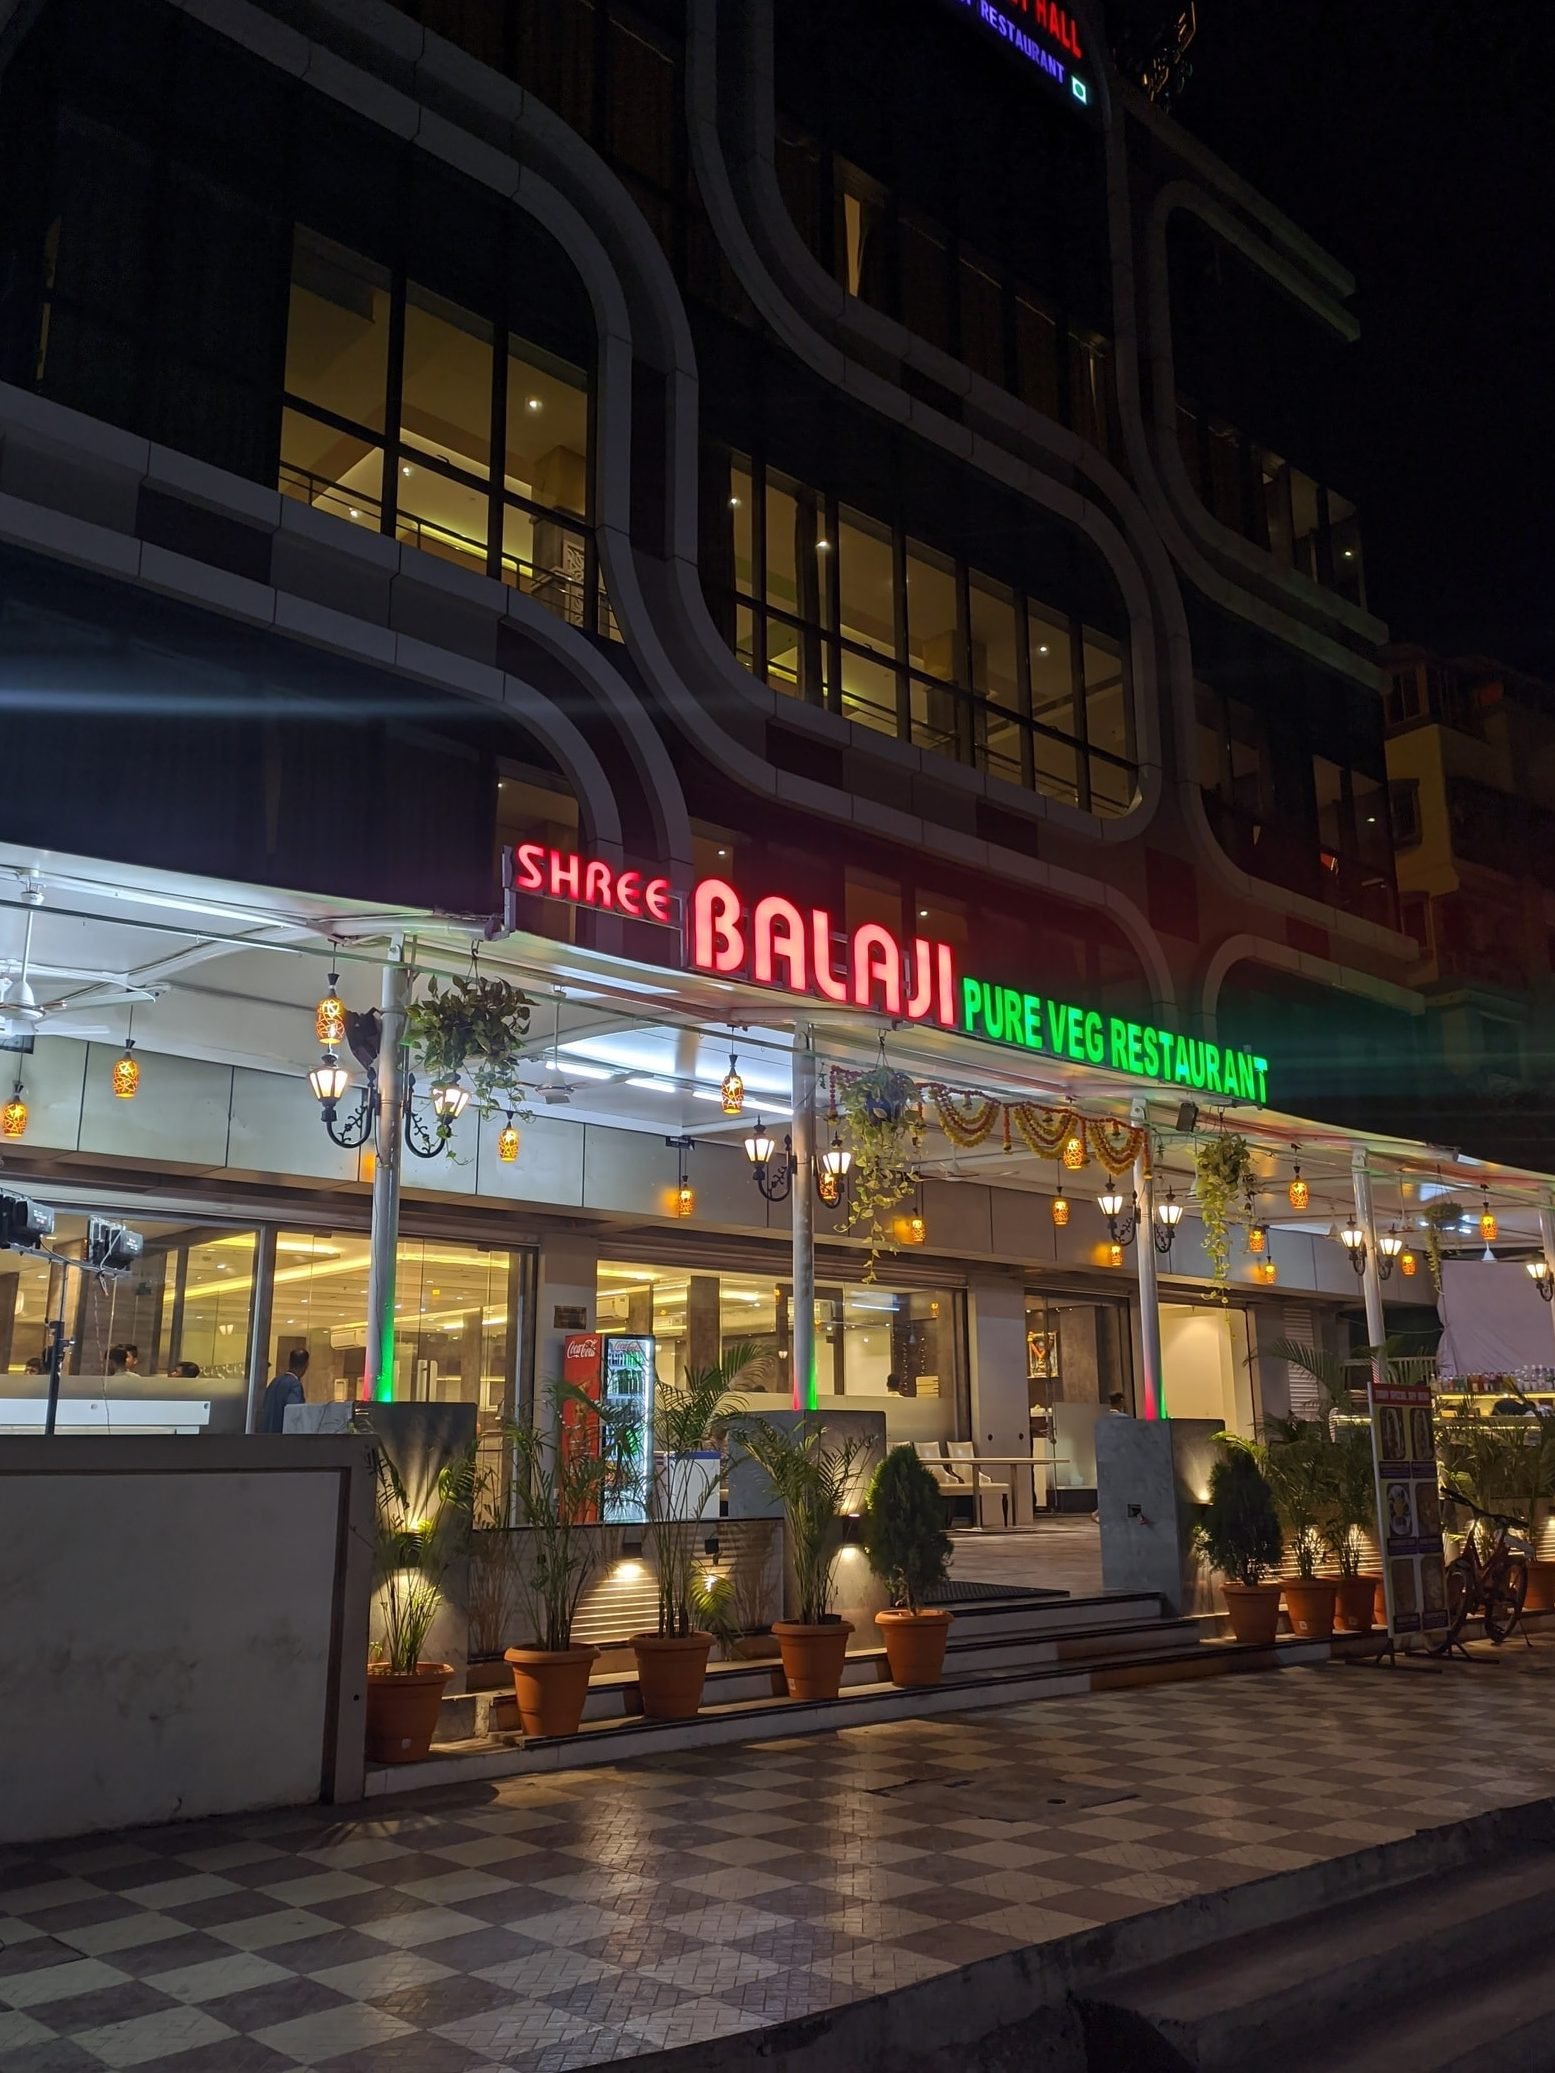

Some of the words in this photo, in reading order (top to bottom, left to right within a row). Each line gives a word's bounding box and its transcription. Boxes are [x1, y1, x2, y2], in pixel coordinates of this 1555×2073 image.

[978, 0, 1066, 85] RESTAURANT
[1034, 0, 1083, 59] HALL
[516, 843, 669, 922] SHREE
[693, 878, 955, 1027] BALAJI
[962, 976, 1043, 1050] PURE
[1047, 999, 1105, 1064] VEG
[1110, 1016, 1269, 1104] RESTAURANT
